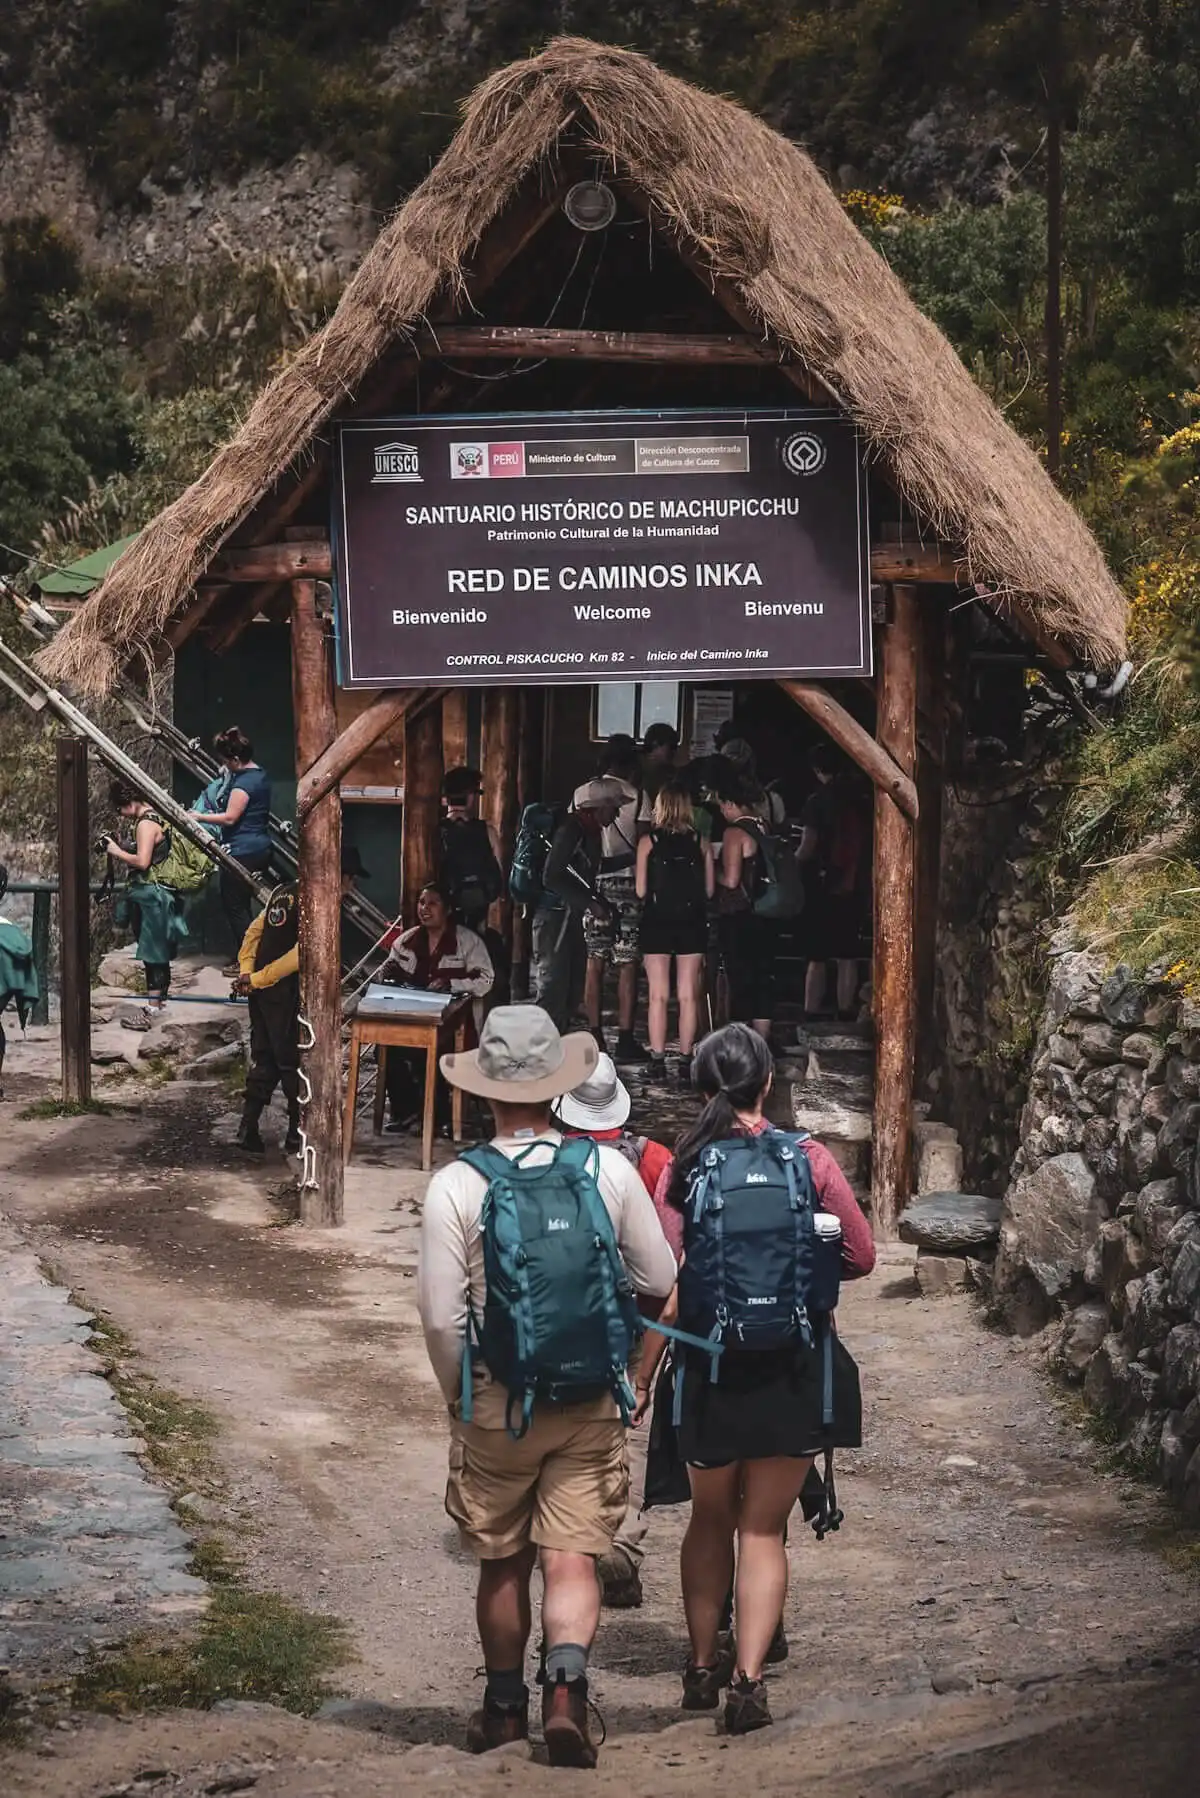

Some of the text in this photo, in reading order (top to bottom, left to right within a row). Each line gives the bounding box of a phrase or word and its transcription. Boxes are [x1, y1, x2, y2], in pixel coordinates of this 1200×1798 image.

[493, 450, 519, 465] PERÚ
[640, 444, 741, 455] Dirección Desconcentrada
[375, 455, 418, 472] UNESCO
[528, 453, 617, 463] Ministerio de Cultura
[642, 458, 653, 467] de
[654, 459, 683, 467] Cultura
[684, 458, 695, 466] de
[405, 498, 800, 525] SANTUARIO HISTÓRICO DE MACHUPICCHU
[487, 525, 719, 541] Patrimonio Cultural de la Humanidad
[447, 562, 763, 592] RED DE CAMINOS INKA
[392, 601, 824, 625] Bienvenido Welcome Bienvenu
[446, 654, 503, 666] CONTROL
[506, 652, 584, 664] PISKACUCHO
[589, 652, 608, 662] Km
[611, 652, 625, 662] 82
[646, 651, 677, 661] Inicio
[679, 650, 697, 660] del
[700, 649, 742, 659] Camino
[745, 648, 769, 658] Inka
